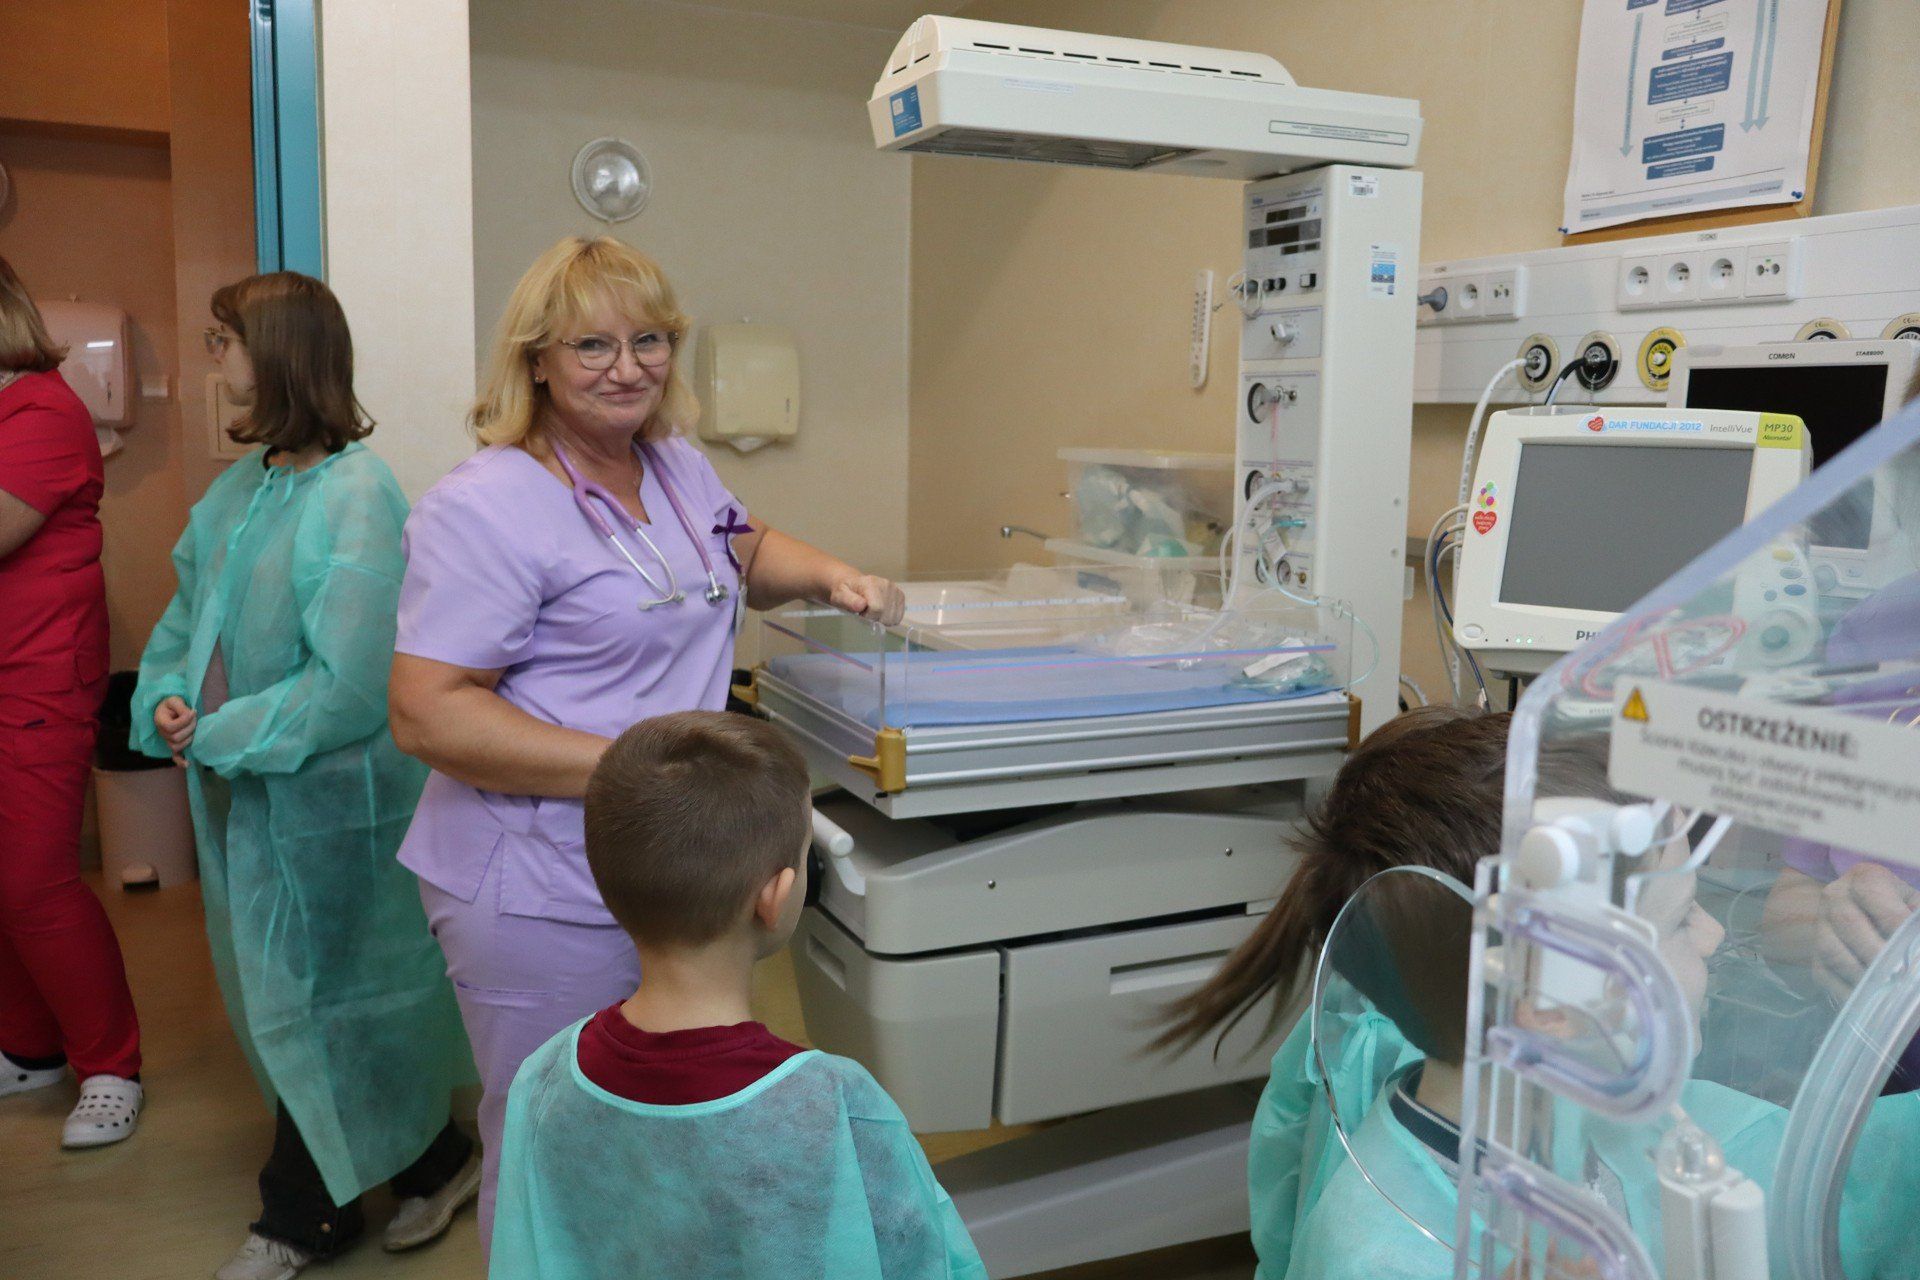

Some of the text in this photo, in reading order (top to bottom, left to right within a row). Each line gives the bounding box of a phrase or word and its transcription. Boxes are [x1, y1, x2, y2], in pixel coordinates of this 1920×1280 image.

[1608, 420, 1628, 430] DAR
[1630, 421, 1677, 431] FUNDACJI
[1680, 422, 1702, 431] 2012
[1709, 423, 1753, 434] IntelliVue
[1764, 423, 1794, 433] MP30
